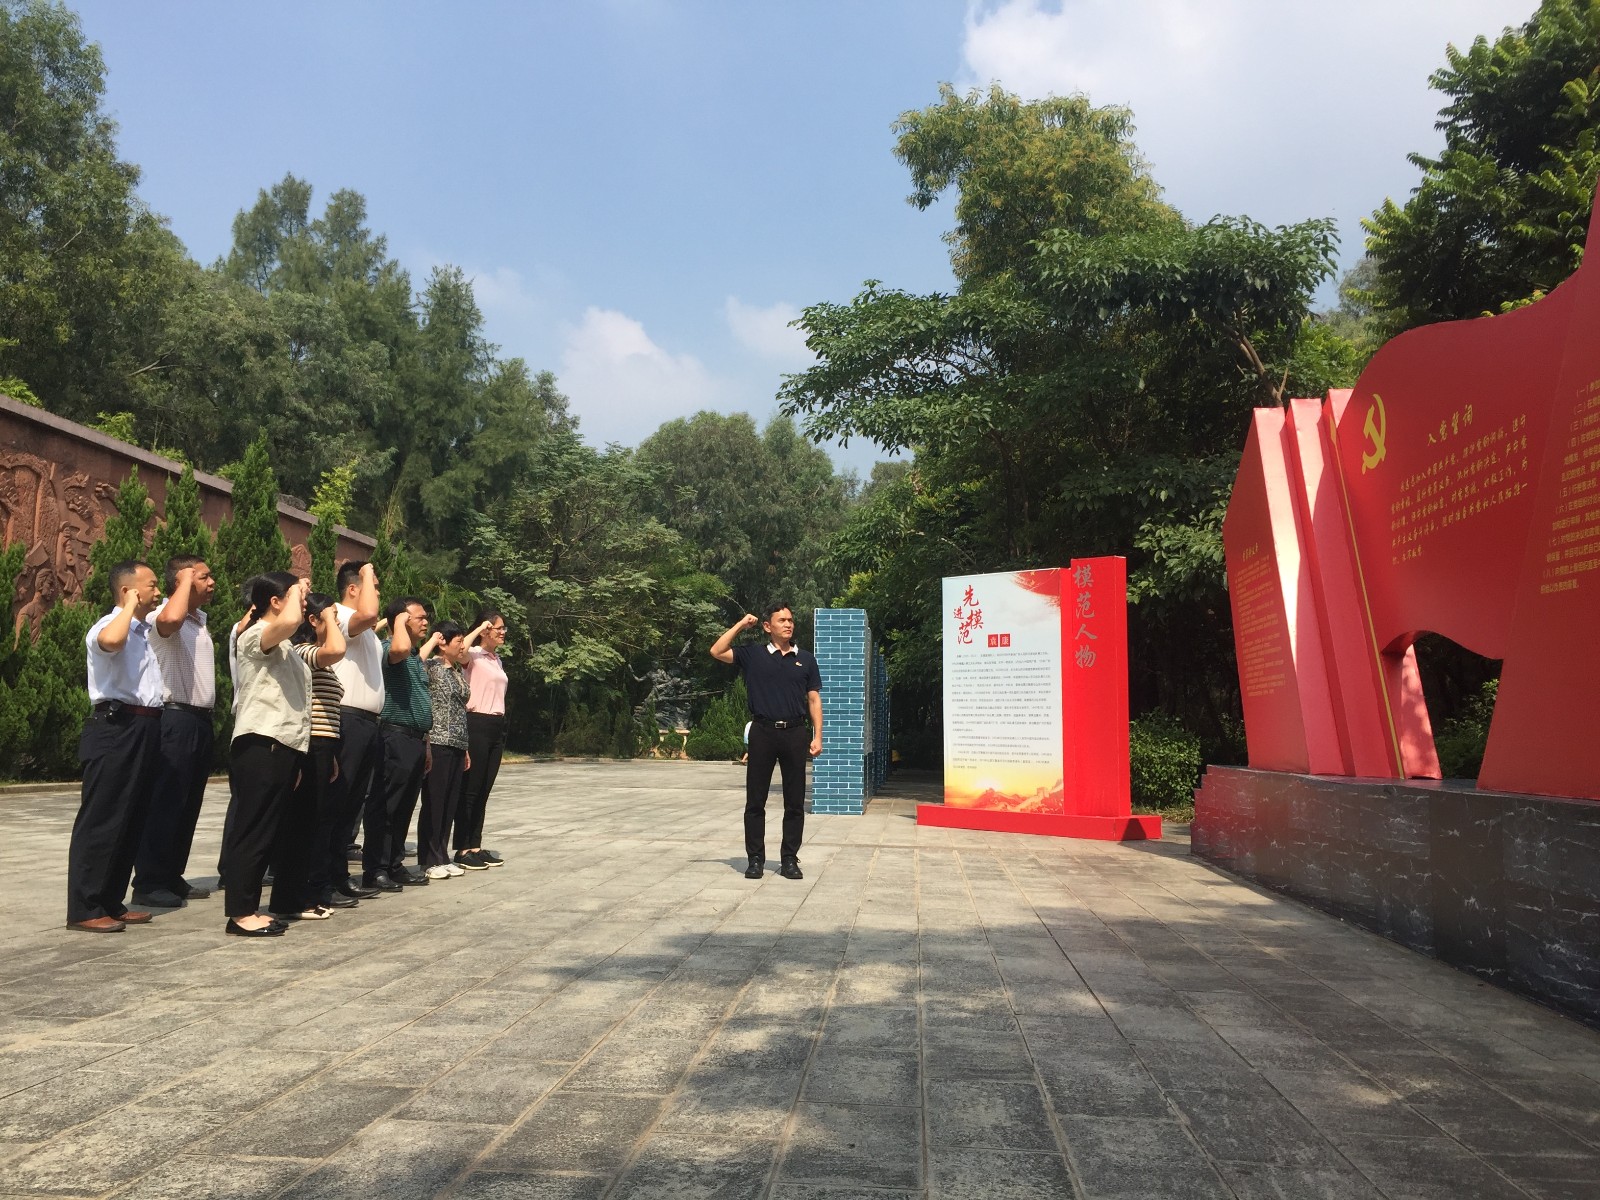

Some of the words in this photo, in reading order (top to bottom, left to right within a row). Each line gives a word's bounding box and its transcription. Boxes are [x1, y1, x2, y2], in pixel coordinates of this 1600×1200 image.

[1428, 404, 1473, 446] 入党誓词
[1073, 564, 1098, 668] 模范人物
